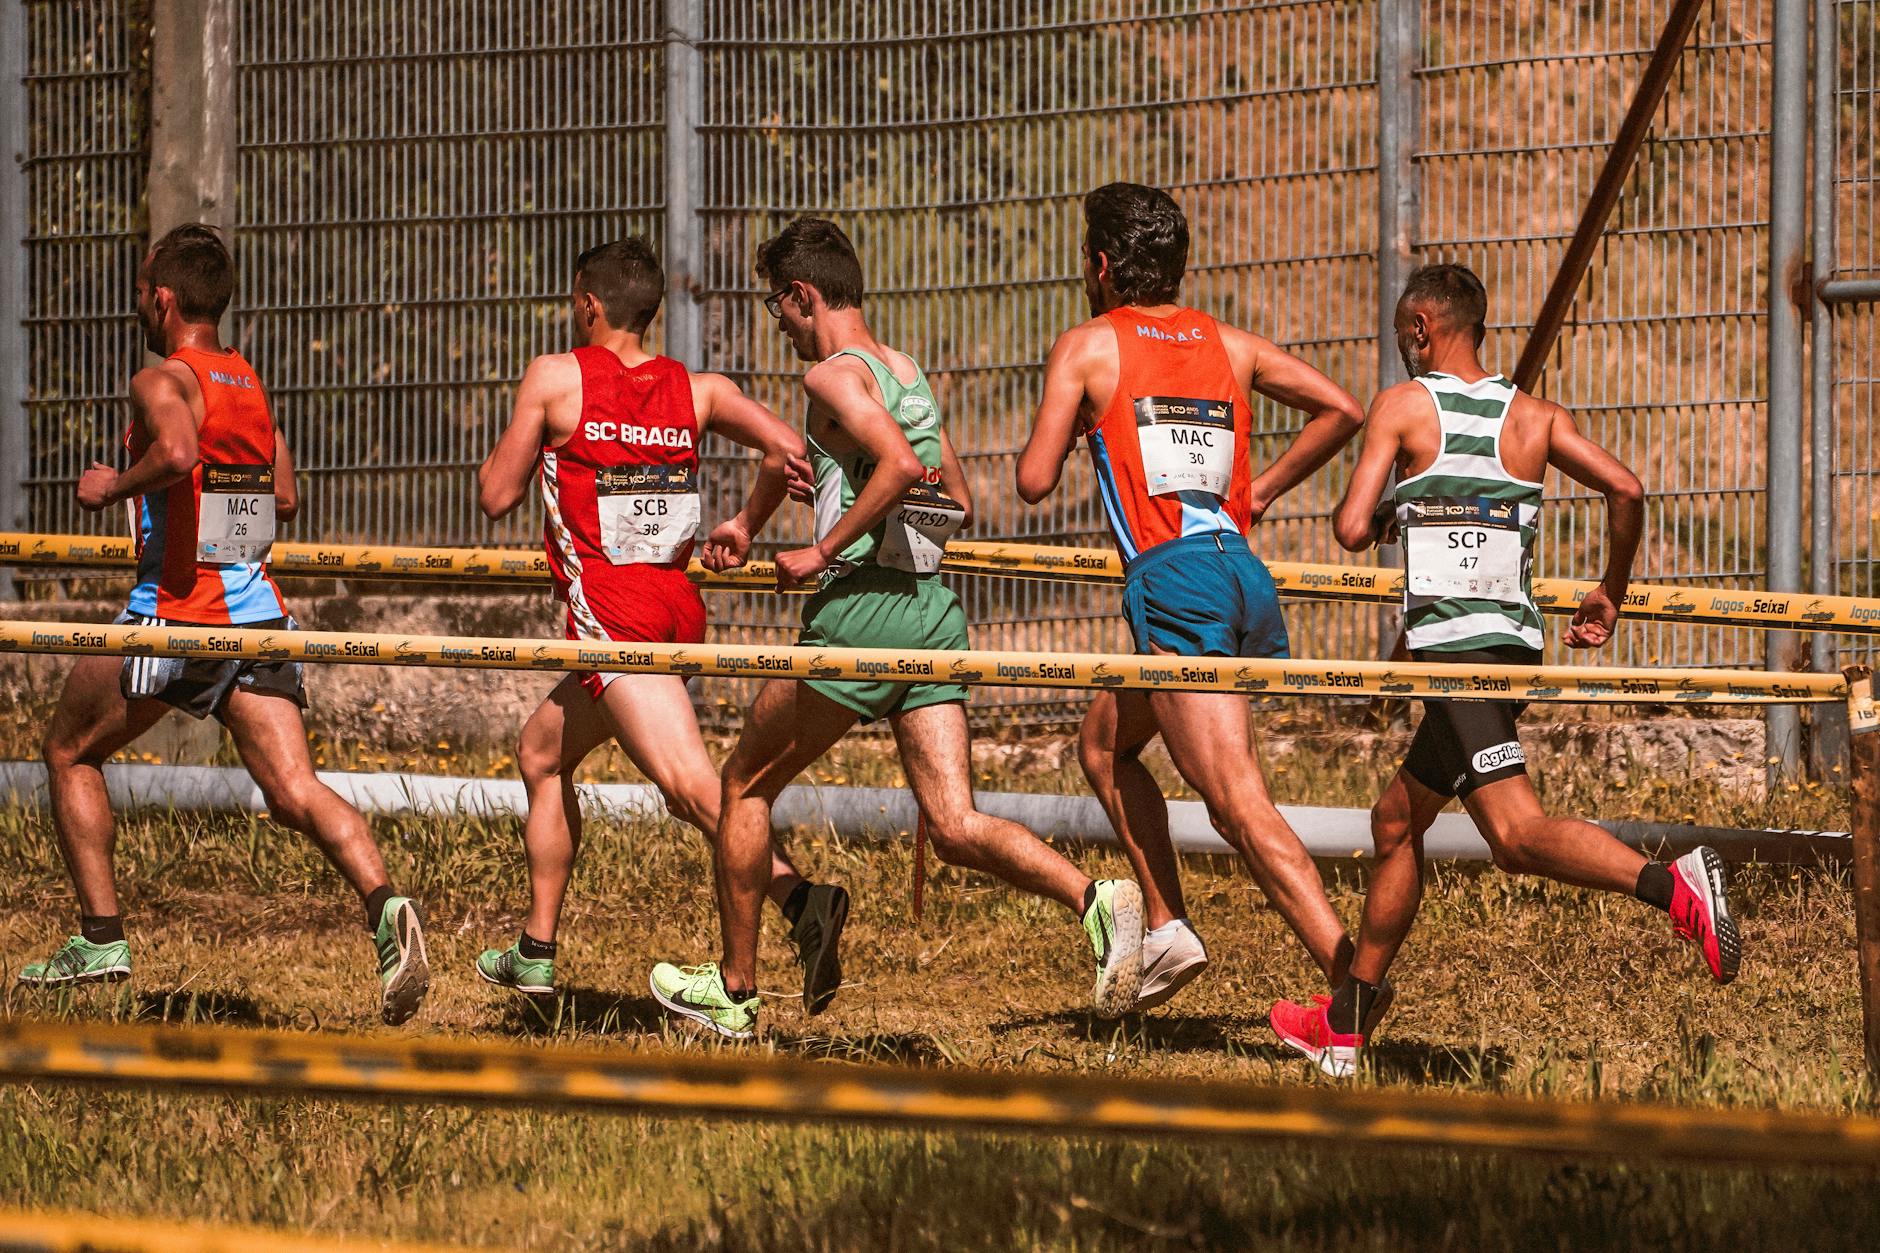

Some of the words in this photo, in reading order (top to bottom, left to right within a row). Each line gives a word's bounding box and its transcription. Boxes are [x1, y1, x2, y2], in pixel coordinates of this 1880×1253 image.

[584, 421, 617, 441] SC
[620, 422, 693, 449] BRAGA
[1170, 428, 1214, 448] MAC
[1188, 452, 1205, 465] 30
[227, 498, 259, 516] MAC
[633, 499, 668, 517] SCB
[1444, 505, 1465, 515] 100
[234, 523, 248, 536] 26
[642, 523, 660, 536] 38
[0, 540, 20, 556] eixal
[1447, 531, 1488, 549] SCP
[317, 551, 344, 567] Seixal
[425, 554, 453, 569] Seixal
[1073, 553, 1108, 570] Seixal
[1458, 557, 1479, 570] 47
[750, 564, 774, 577] Seixa
[1341, 572, 1377, 589] Seixal
[1622, 591, 1650, 607] eixal
[1752, 598, 1789, 615] Seixal
[73, 631, 107, 648] Seixal
[208, 636, 243, 653] Seixal
[344, 641, 379, 658] Seixal
[481, 646, 516, 662] Seixal
[619, 650, 654, 667] Seixal
[757, 655, 793, 671] Seixal
[898, 659, 933, 675] Seixal
[1039, 663, 1075, 680] Seixal
[1182, 667, 1218, 684] Seixal
[1327, 671, 1363, 687] Seixal
[1473, 675, 1511, 692] Seixal
